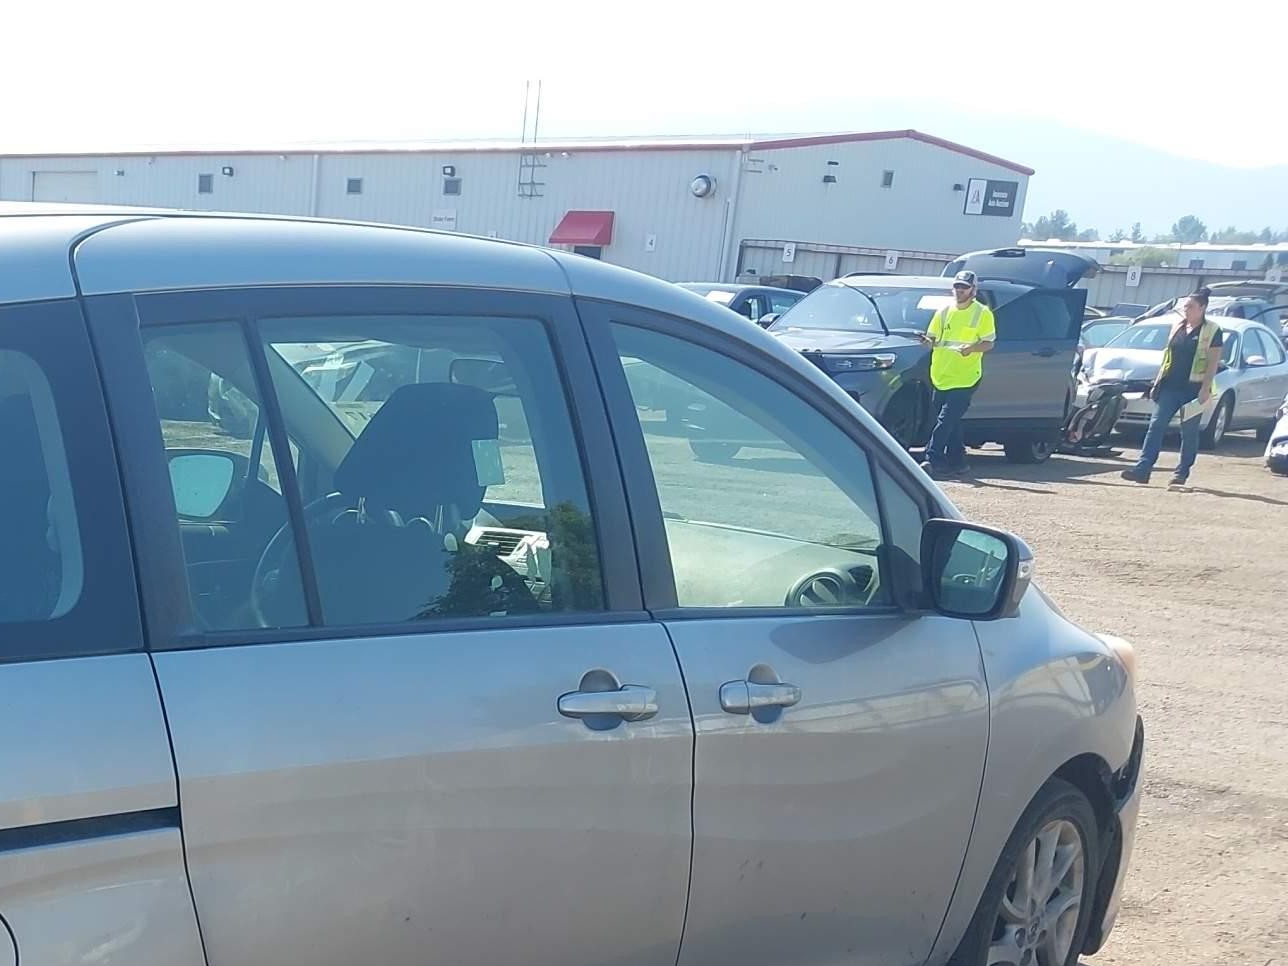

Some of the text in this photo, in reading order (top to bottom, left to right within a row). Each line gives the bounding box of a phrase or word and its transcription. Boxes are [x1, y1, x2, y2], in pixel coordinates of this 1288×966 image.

[786, 248, 792, 257] 5
[888, 256, 894, 265] 6
[1130, 271, 1137, 281] 8
